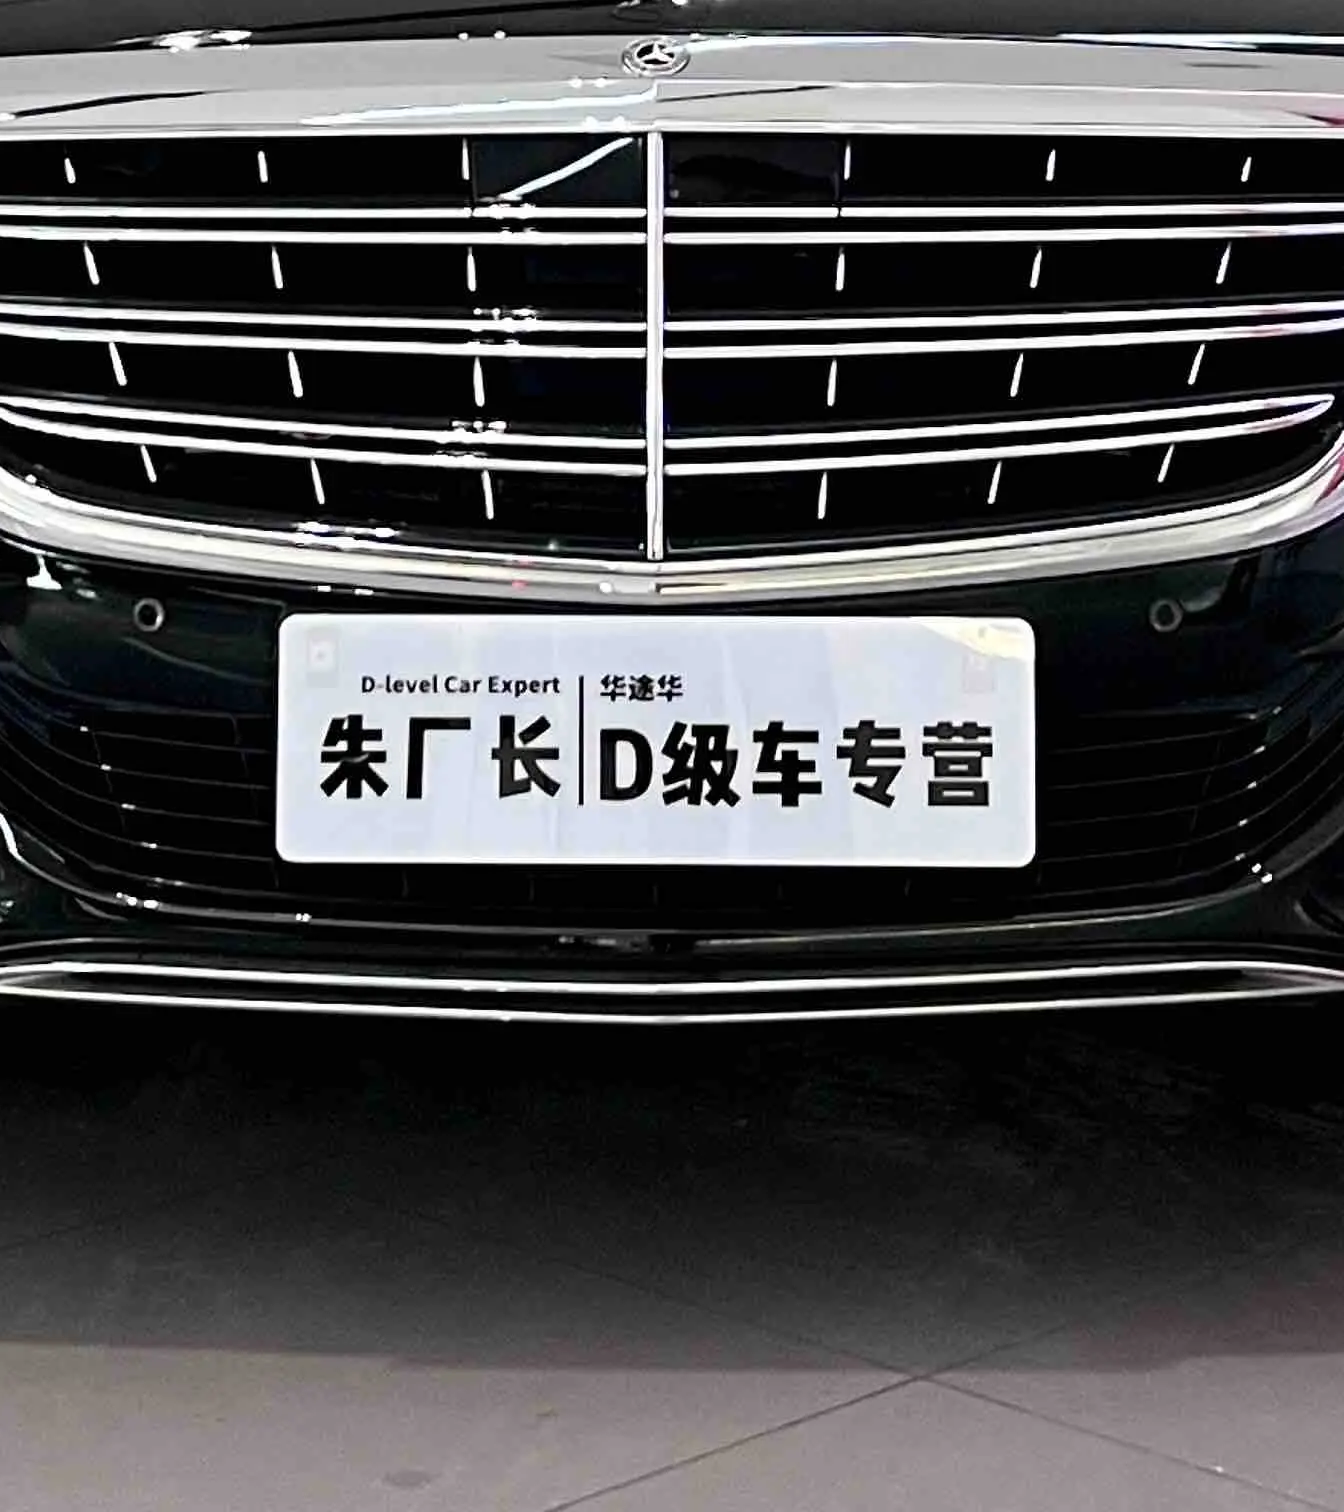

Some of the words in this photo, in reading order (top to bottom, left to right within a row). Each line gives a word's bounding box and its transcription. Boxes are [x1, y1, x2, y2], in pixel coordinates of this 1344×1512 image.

[361, 675, 438, 694] D-level
[444, 675, 482, 694] Car
[488, 675, 561, 698] Expert
[600, 674, 684, 702] 华途华
[319, 714, 561, 799] 朱厂长
[599, 719, 994, 807] D级车专营
